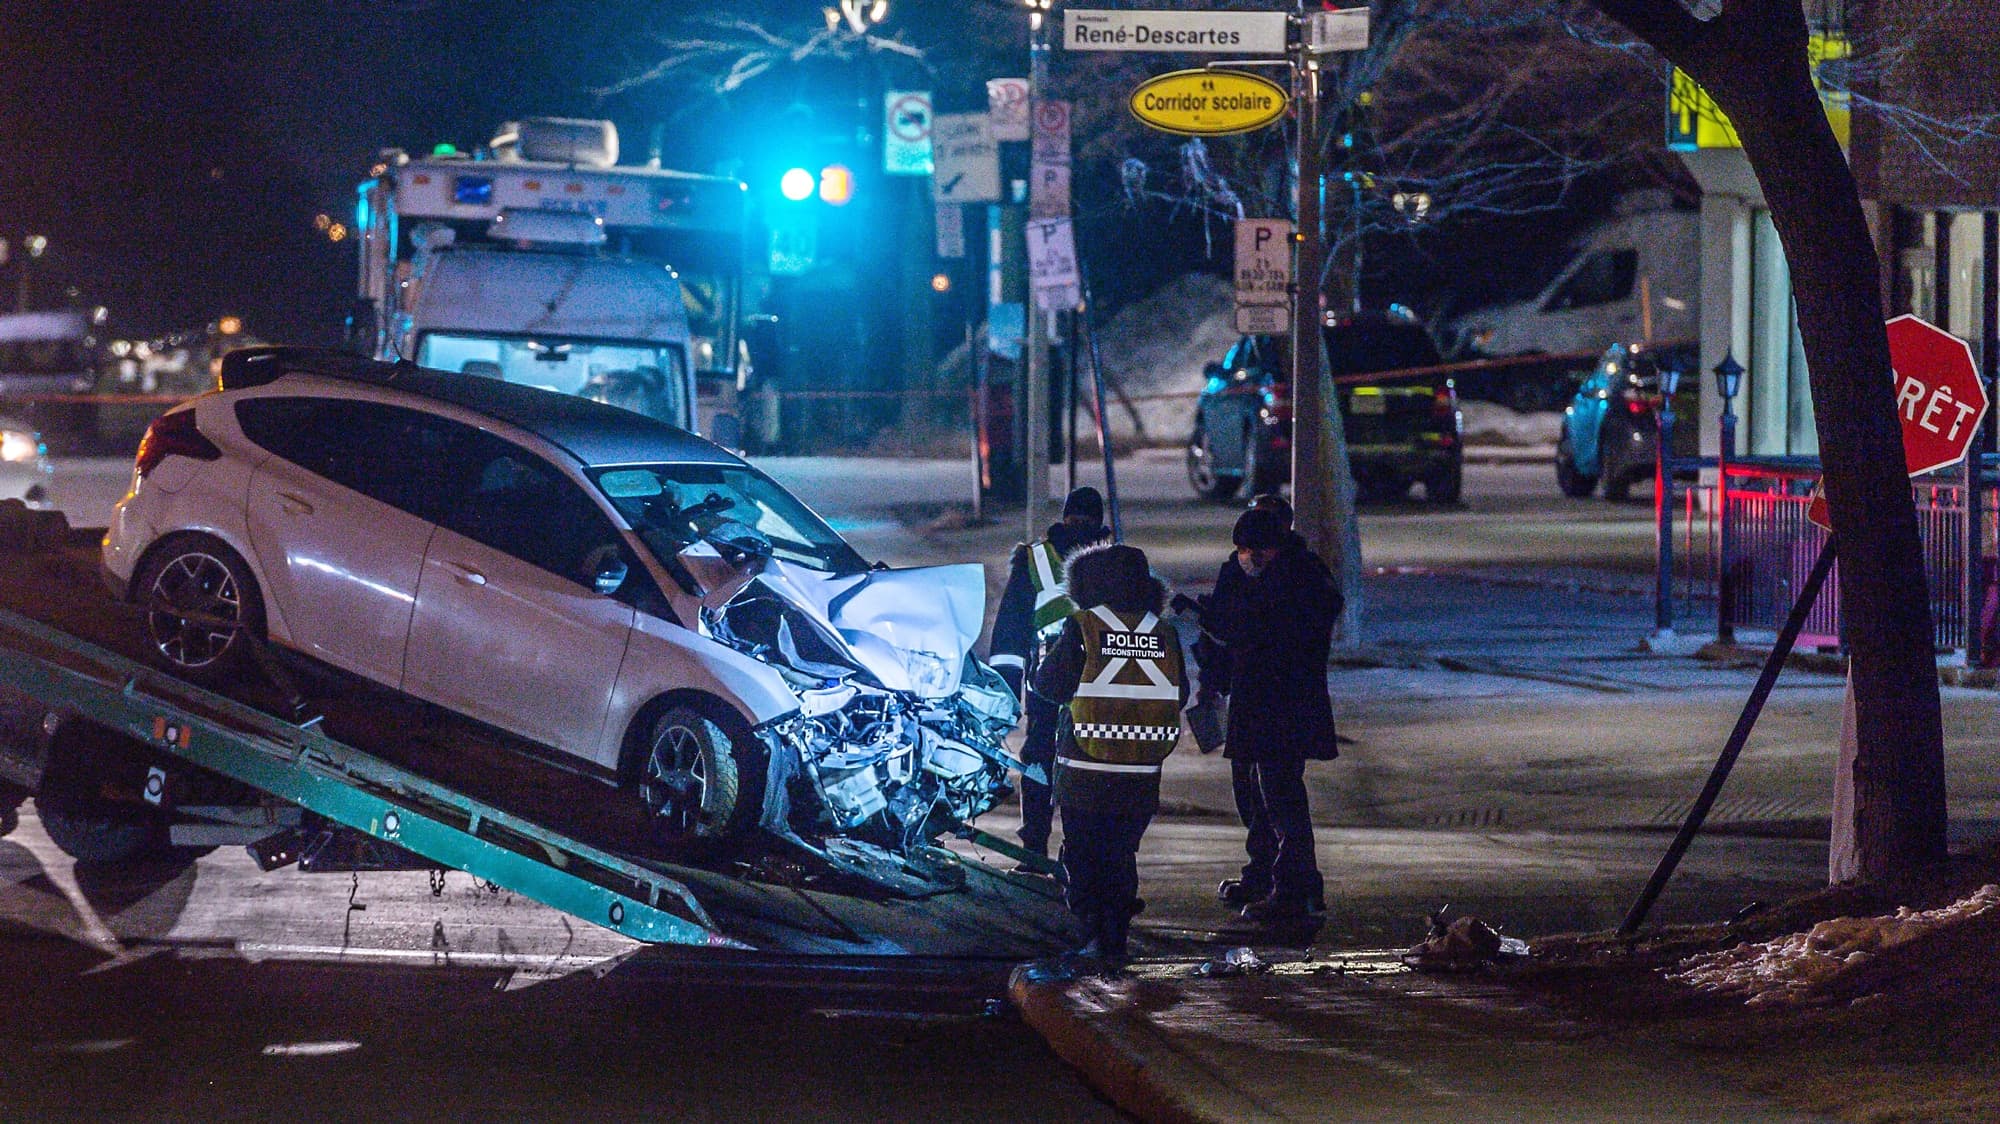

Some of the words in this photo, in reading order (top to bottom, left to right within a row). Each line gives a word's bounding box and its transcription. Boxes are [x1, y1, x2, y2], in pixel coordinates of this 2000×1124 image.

[1074, 25, 1240, 44] René-Descartes
[1144, 93, 1206, 111] Corridor
[1212, 92, 1272, 110] scolaire
[1042, 224, 1056, 244] P
[1256, 227, 1272, 251] P
[1893, 368, 1975, 441] RÊT
[1107, 633, 1158, 649] POLICE
[1102, 647, 1165, 658] RECONSTITUTION
